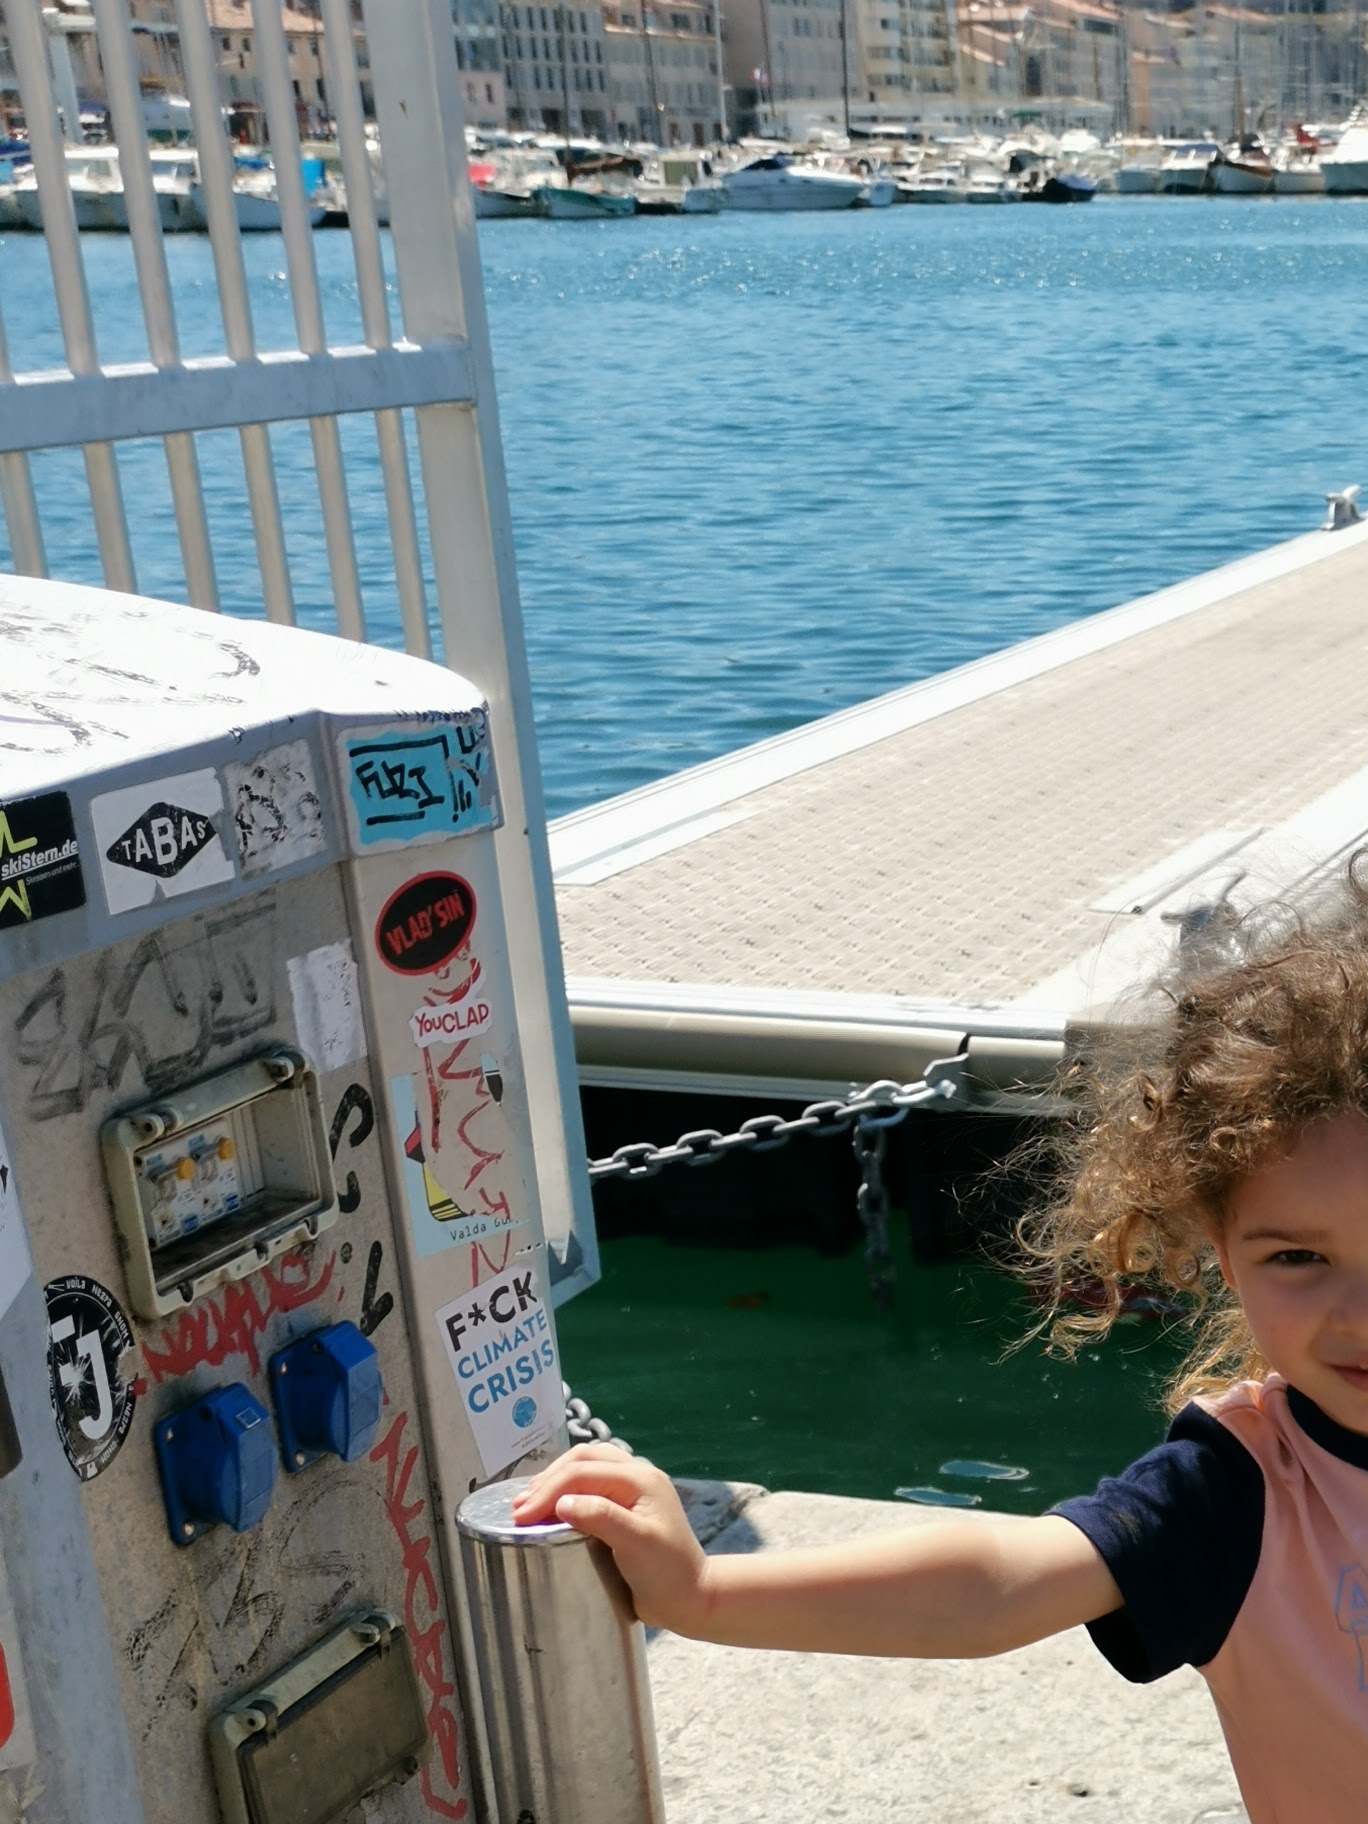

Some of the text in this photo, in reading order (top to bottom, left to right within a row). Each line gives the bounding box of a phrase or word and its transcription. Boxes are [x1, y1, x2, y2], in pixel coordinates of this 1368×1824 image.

[121, 816, 208, 866] TABAS
[450, 1220, 487, 1241] Valda
[457, 1308, 547, 1379] CLIMATE
[468, 1339, 554, 1414] CRISIS
